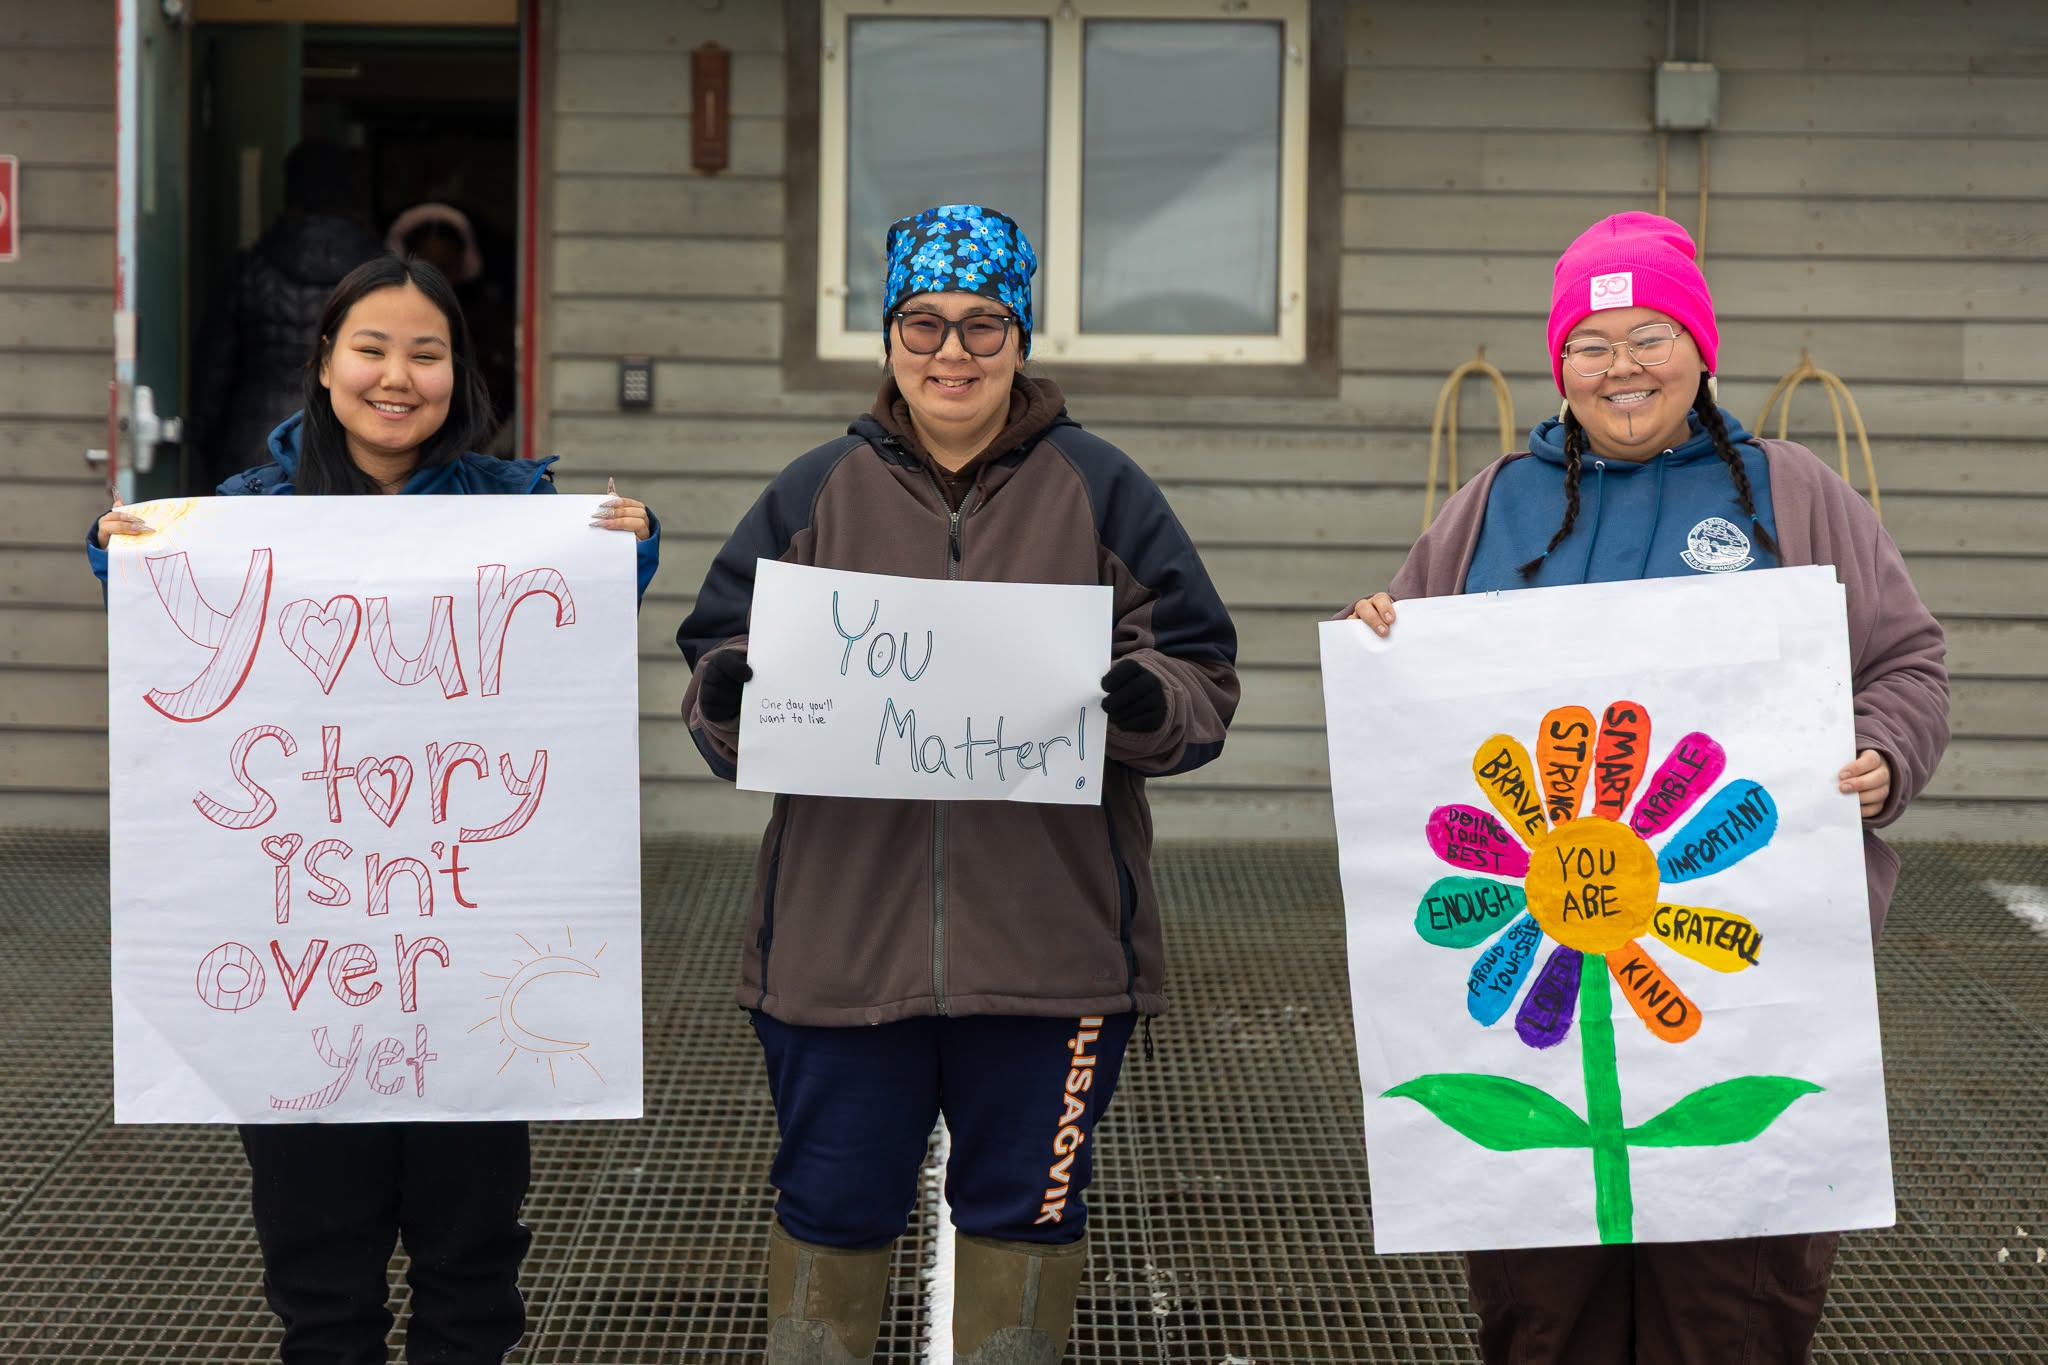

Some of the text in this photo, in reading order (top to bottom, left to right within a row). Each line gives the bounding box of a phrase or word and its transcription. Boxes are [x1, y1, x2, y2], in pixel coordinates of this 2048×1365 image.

[761, 698, 833, 716] One day you'll
[791, 712, 803, 724] to
[807, 713, 827, 724] live
[875, 697, 1086, 790] Matter!
[1478, 748, 1545, 836] BRAVE
[1545, 721, 1589, 821] STRONG
[1597, 706, 1637, 812] SMART
[1634, 743, 1709, 834] CAPABLE
[1445, 823, 1489, 847] YOUR
[1447, 842, 1504, 871] BEST
[1449, 808, 1508, 844] DOING
[1556, 845, 1616, 882] YOU
[1667, 785, 1771, 879] IMPORTANT
[261, 834, 477, 924] isn't
[1427, 884, 1515, 930] ENOUGH
[1563, 884, 1622, 922] ARE
[196, 933, 449, 1014] over
[1467, 923, 1525, 997] PROUD OF
[1488, 918, 1541, 995] YOURSELF
[1520, 954, 1572, 1032] LOVED
[1619, 957, 1688, 1028] KIND
[270, 1023, 438, 1112] yet
